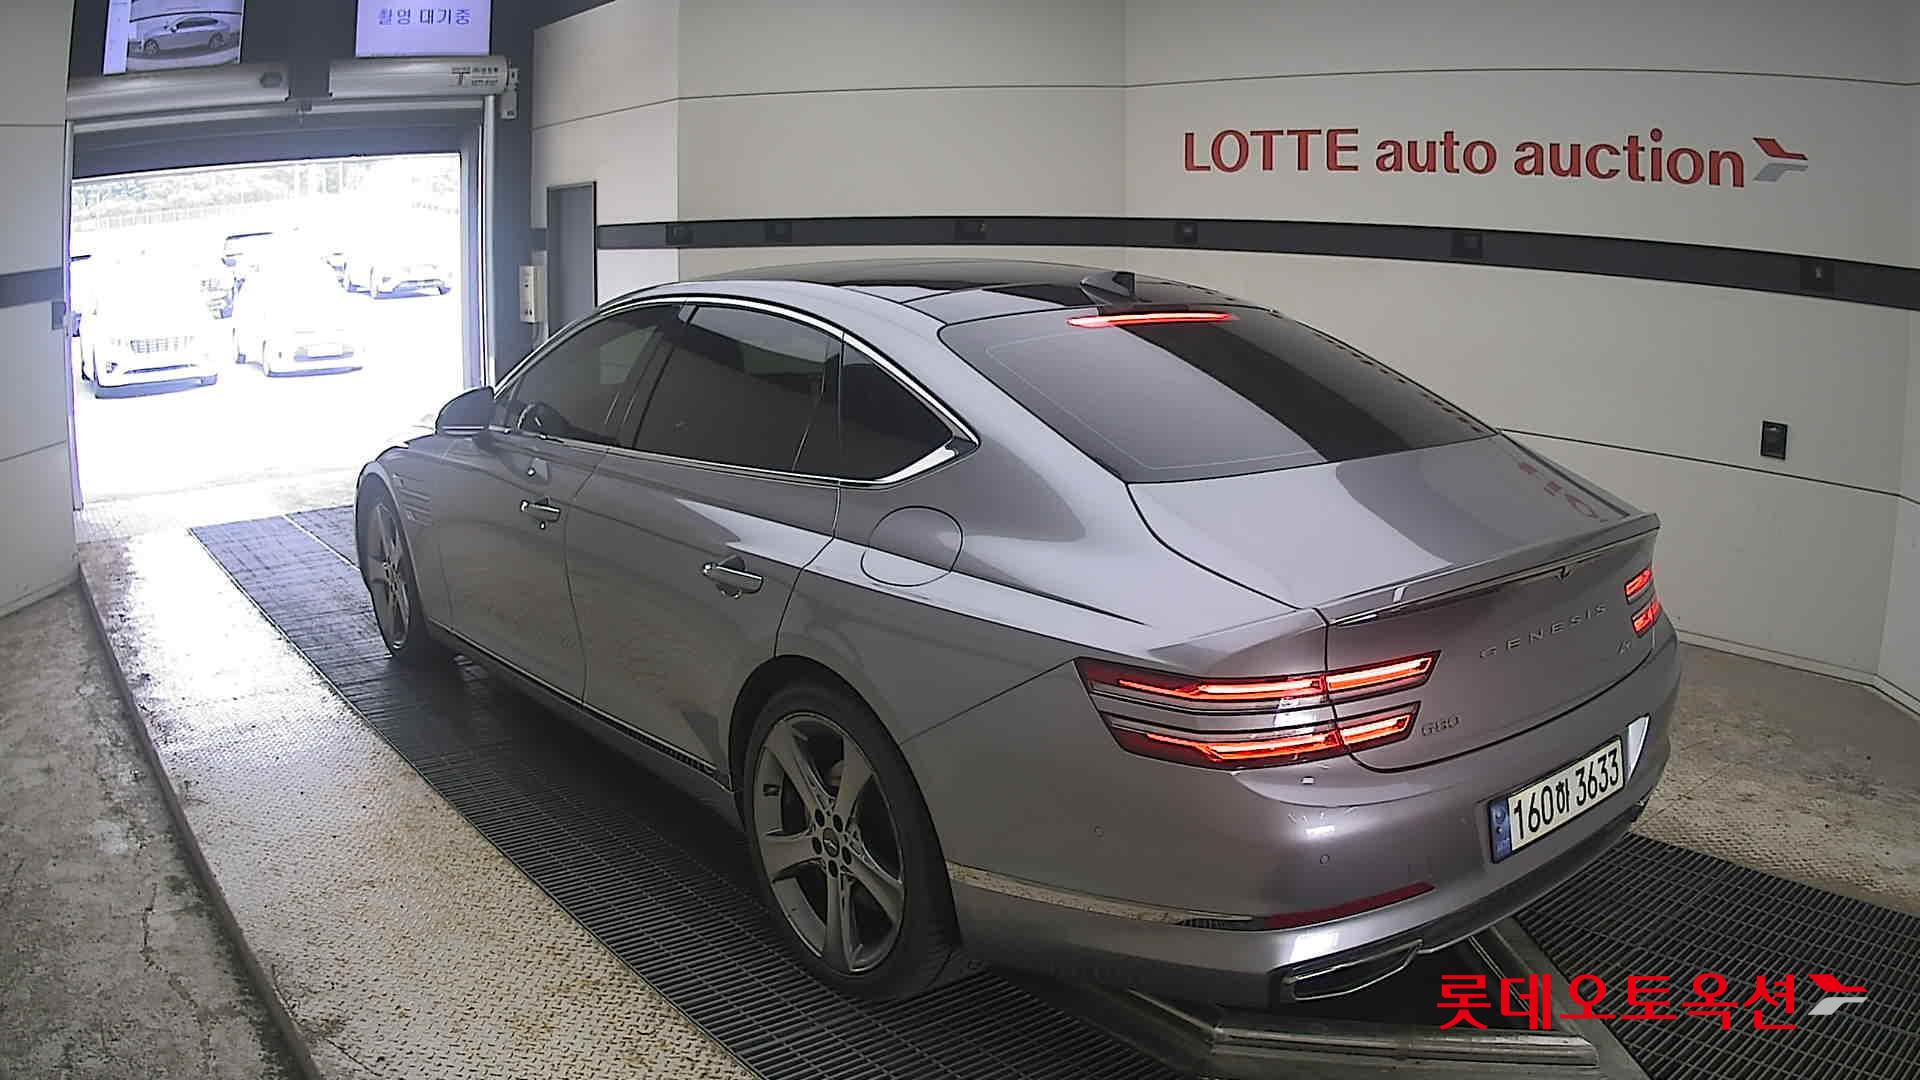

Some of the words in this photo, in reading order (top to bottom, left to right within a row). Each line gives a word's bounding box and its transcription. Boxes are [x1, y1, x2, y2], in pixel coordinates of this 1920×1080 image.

[419, 8, 471, 25] 대기중
[1184, 127, 1360, 172] LOTTE
[1376, 130, 1497, 174] auto
[1514, 127, 1745, 188] auction
[1479, 603, 1607, 658] GENESIS
[1513, 777, 1570, 840] 160하
[1575, 747, 1619, 806] 3633
